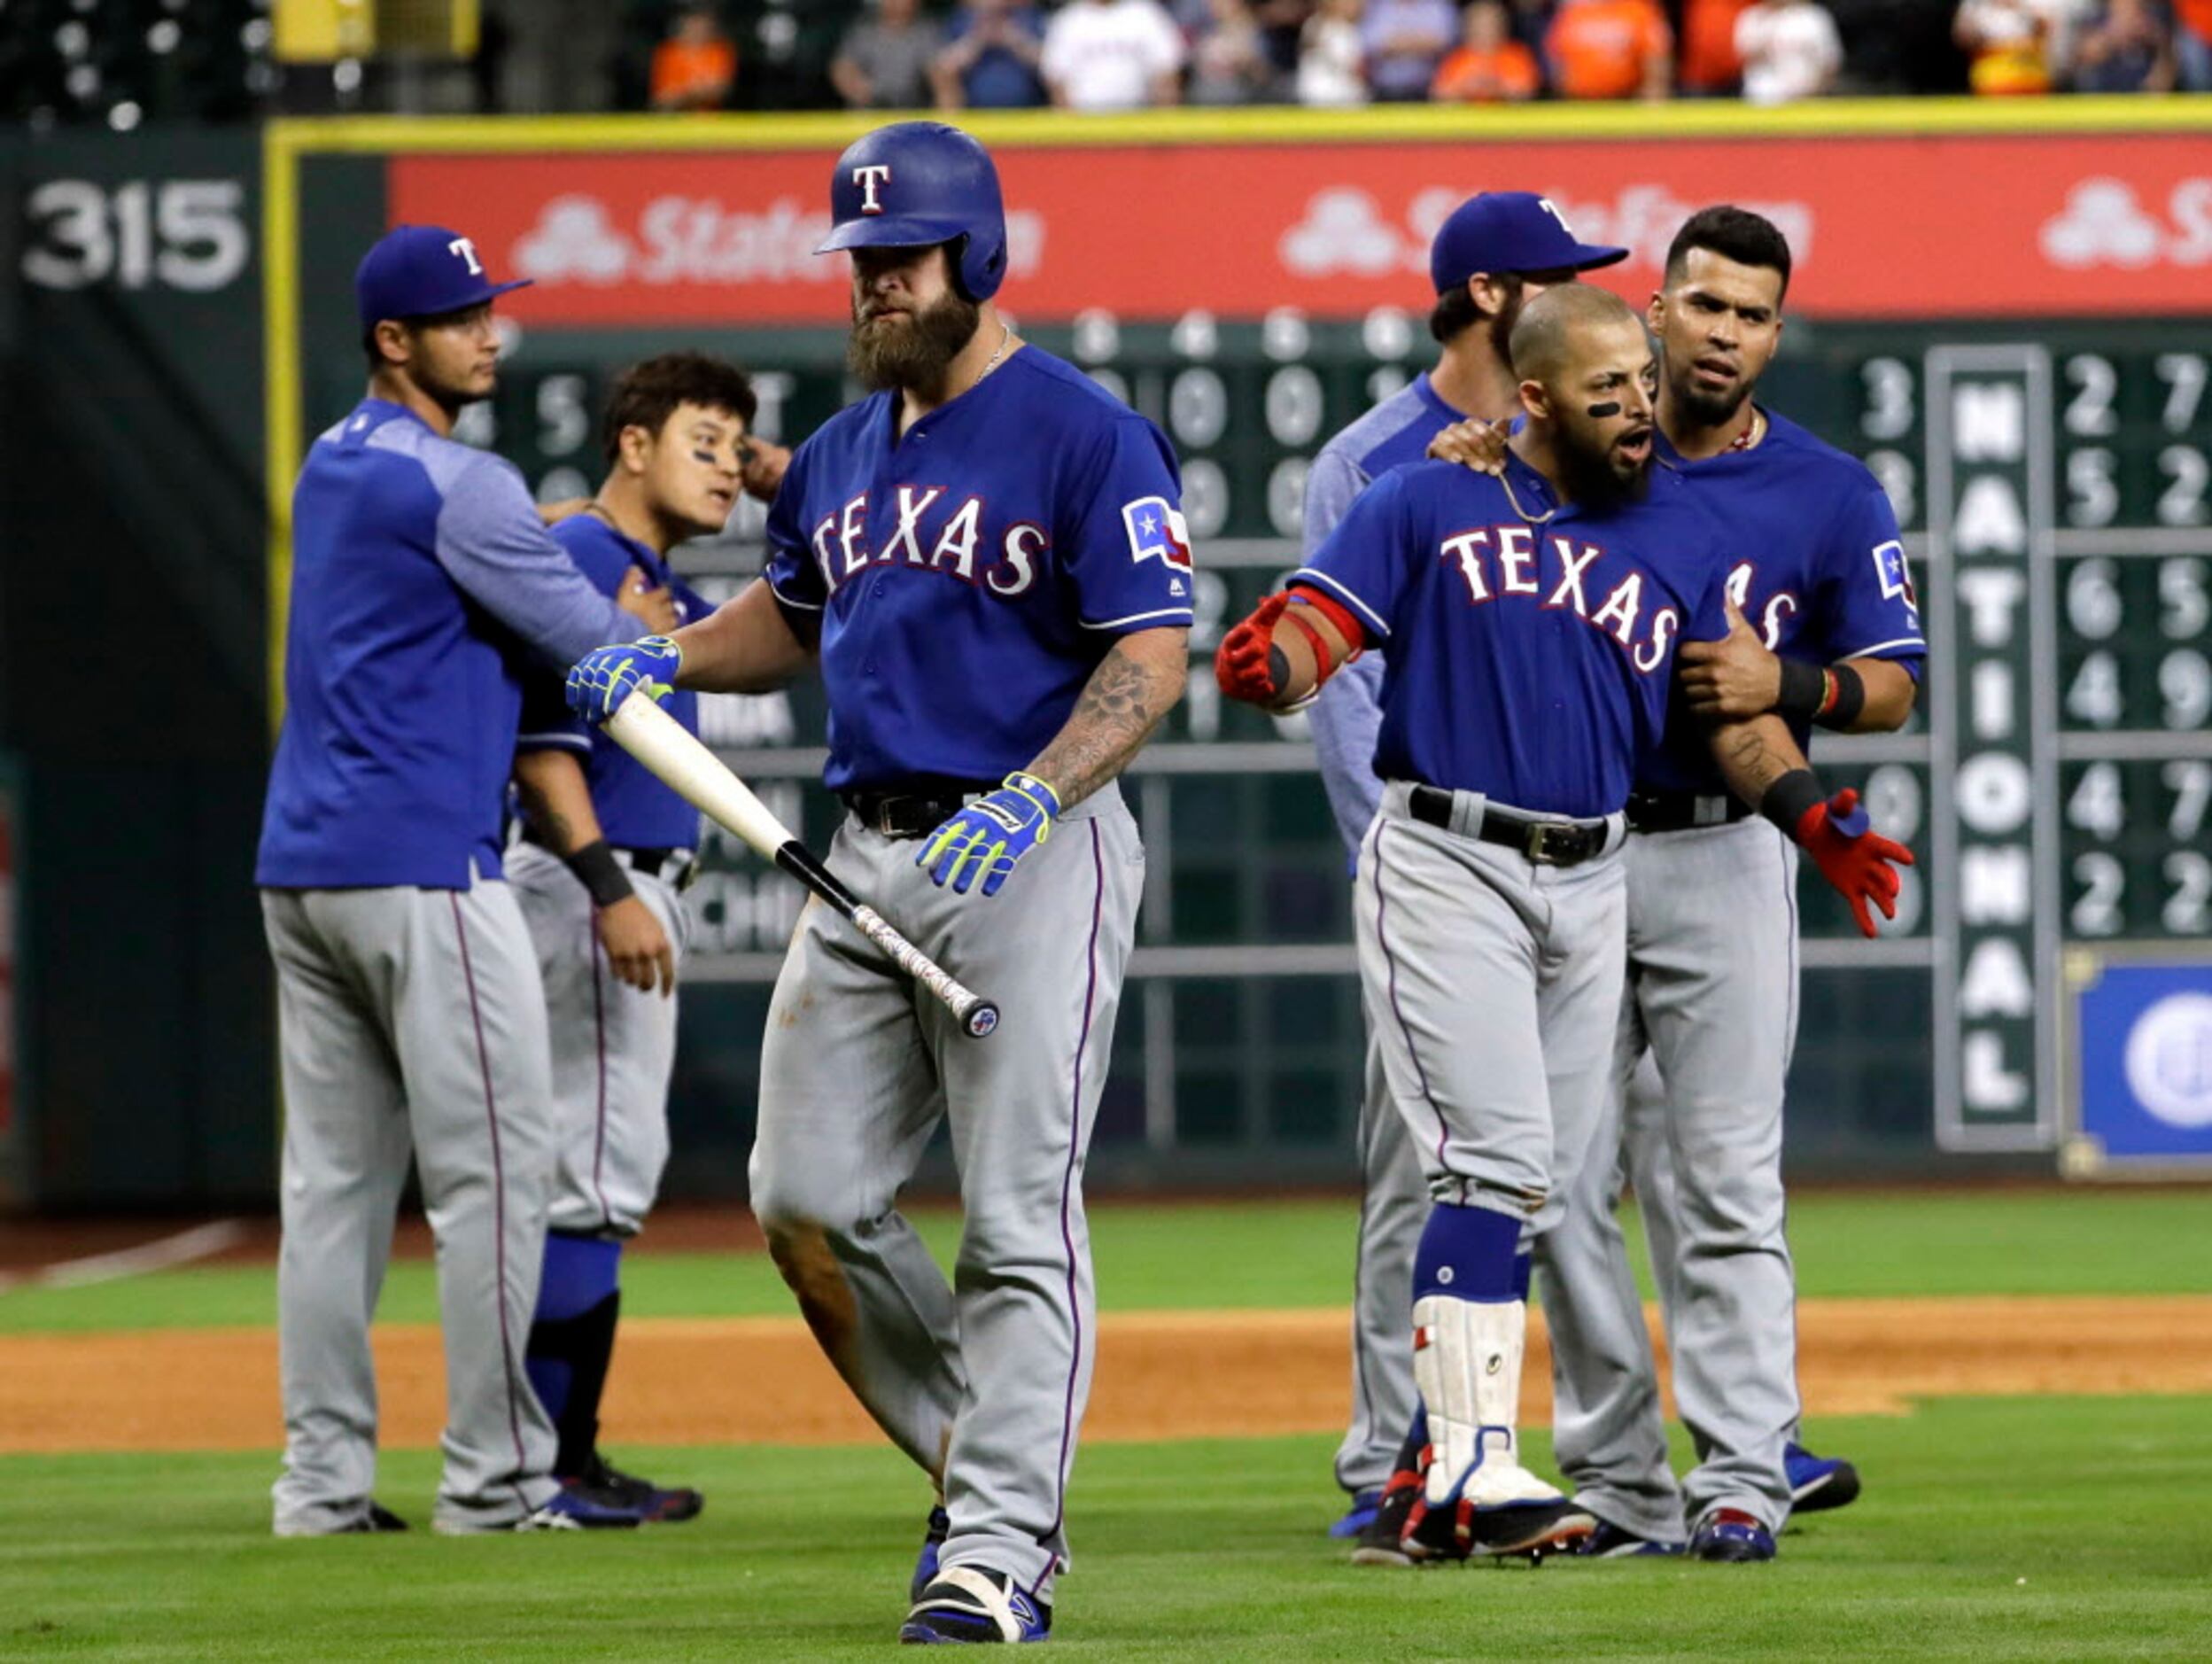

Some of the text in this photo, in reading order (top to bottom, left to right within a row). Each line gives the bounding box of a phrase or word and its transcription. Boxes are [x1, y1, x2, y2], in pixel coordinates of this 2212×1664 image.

[22, 180, 250, 291] 315
[852, 164, 891, 215] T
[448, 236, 484, 276] T
[813, 485, 1049, 598] TEXAS
[1440, 525, 1680, 673] TEXAS
